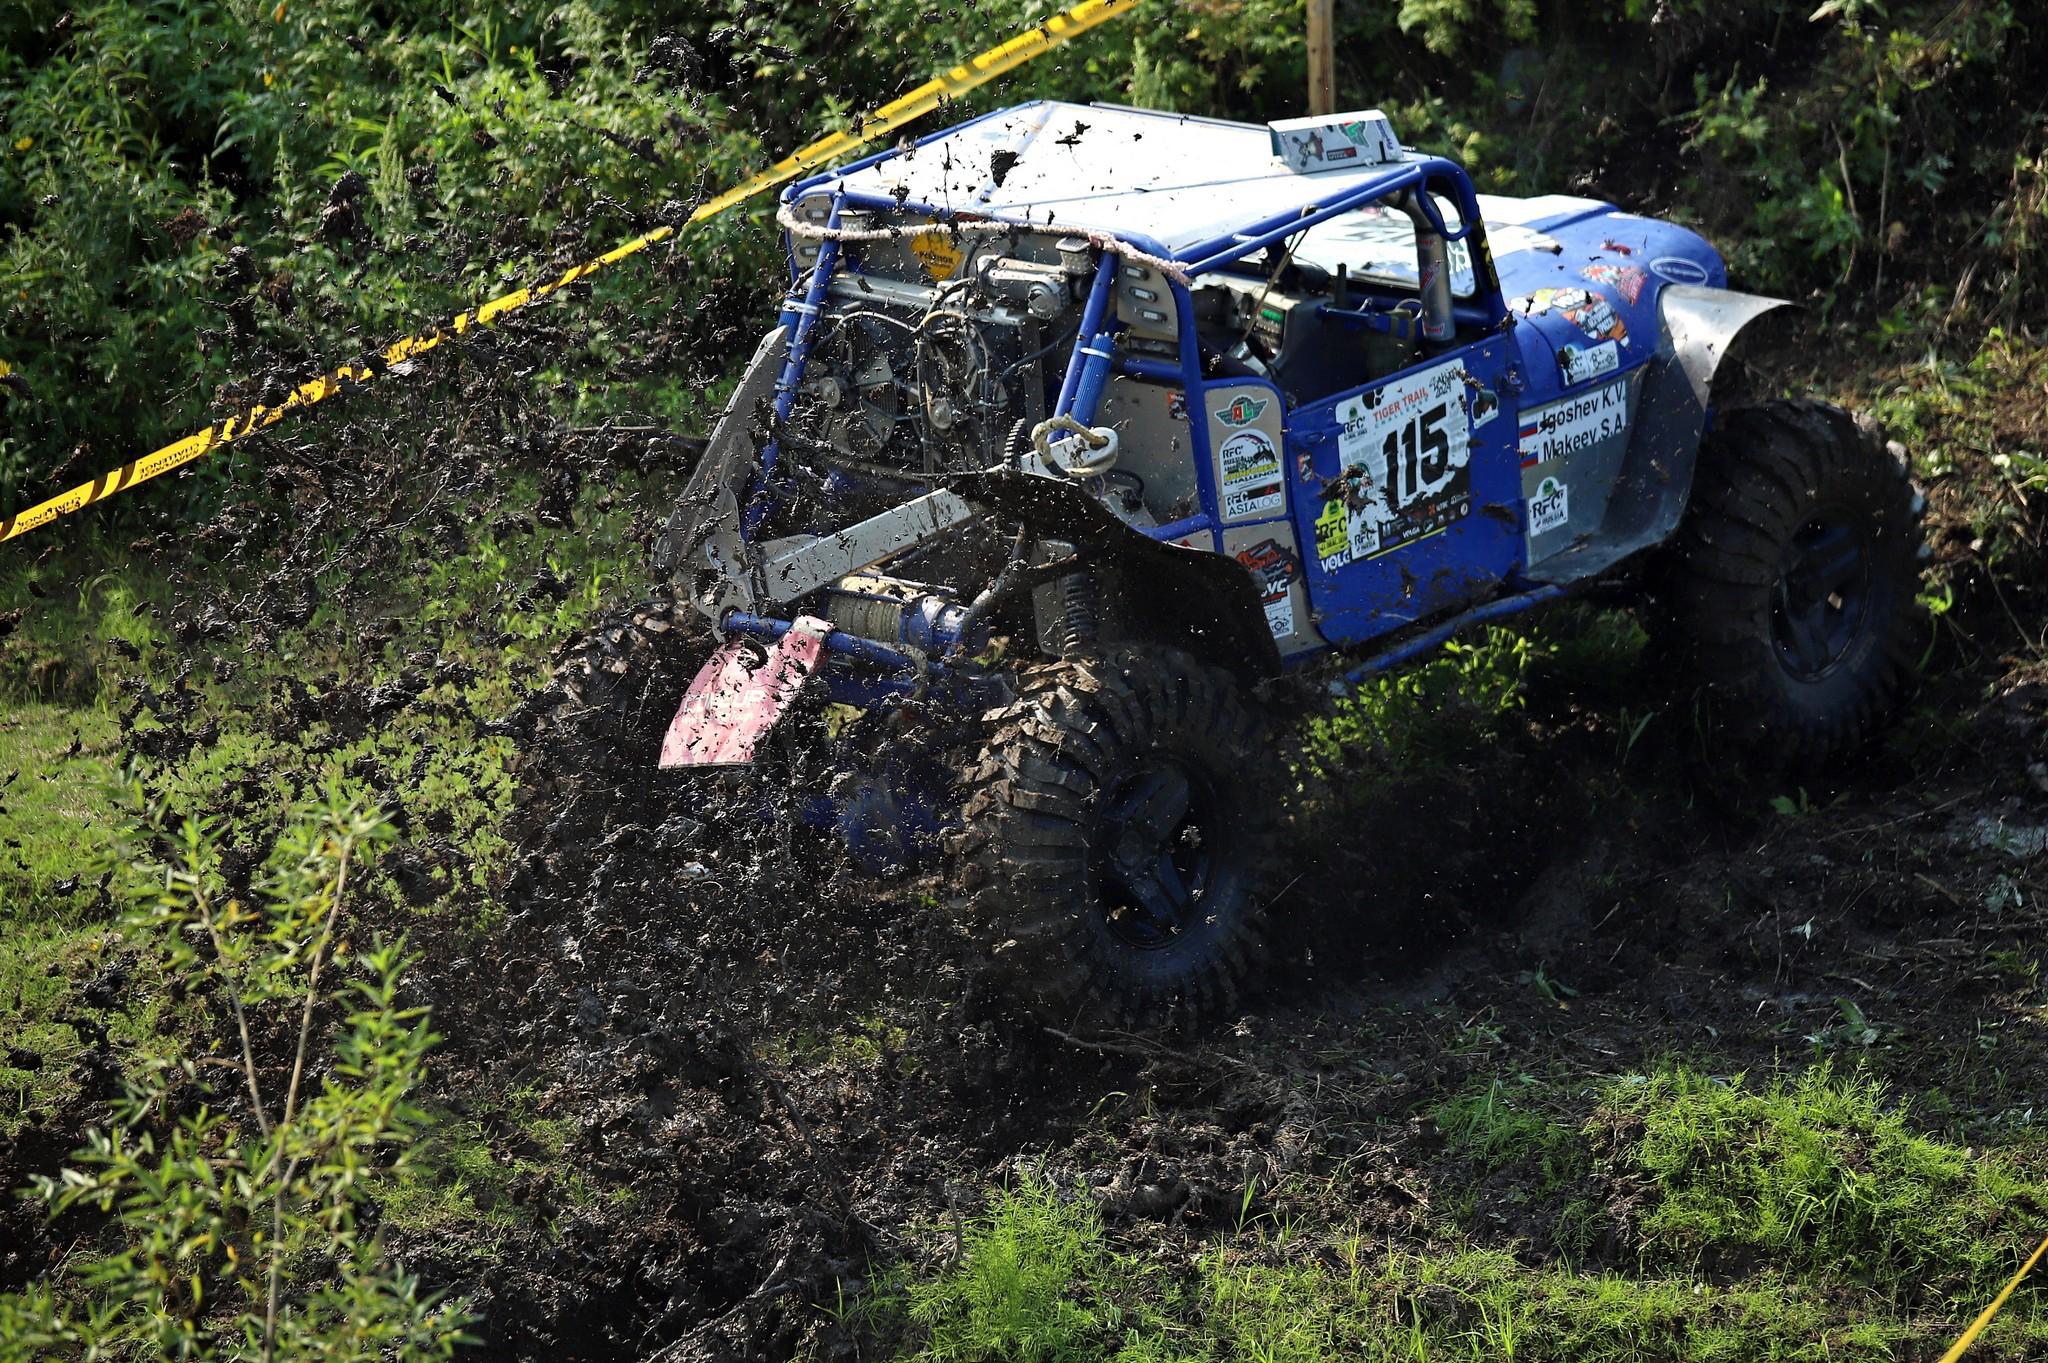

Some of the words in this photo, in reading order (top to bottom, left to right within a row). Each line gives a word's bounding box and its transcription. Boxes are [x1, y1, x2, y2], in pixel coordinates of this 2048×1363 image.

[1373, 400, 1401, 421] TIGER
[1402, 387, 1429, 408] TRAIL
[1342, 416, 1366, 434] RFC
[1222, 445, 1244, 459] RFC
[1383, 402, 1449, 508] 115
[1543, 428, 1598, 462] Makeev
[1224, 469, 1279, 486] CHALLENGE
[1227, 490, 1248, 506] RFC
[1532, 490, 1562, 519] RFC
[1319, 516, 1347, 540] RFC
[1260, 578, 1288, 598] VC
